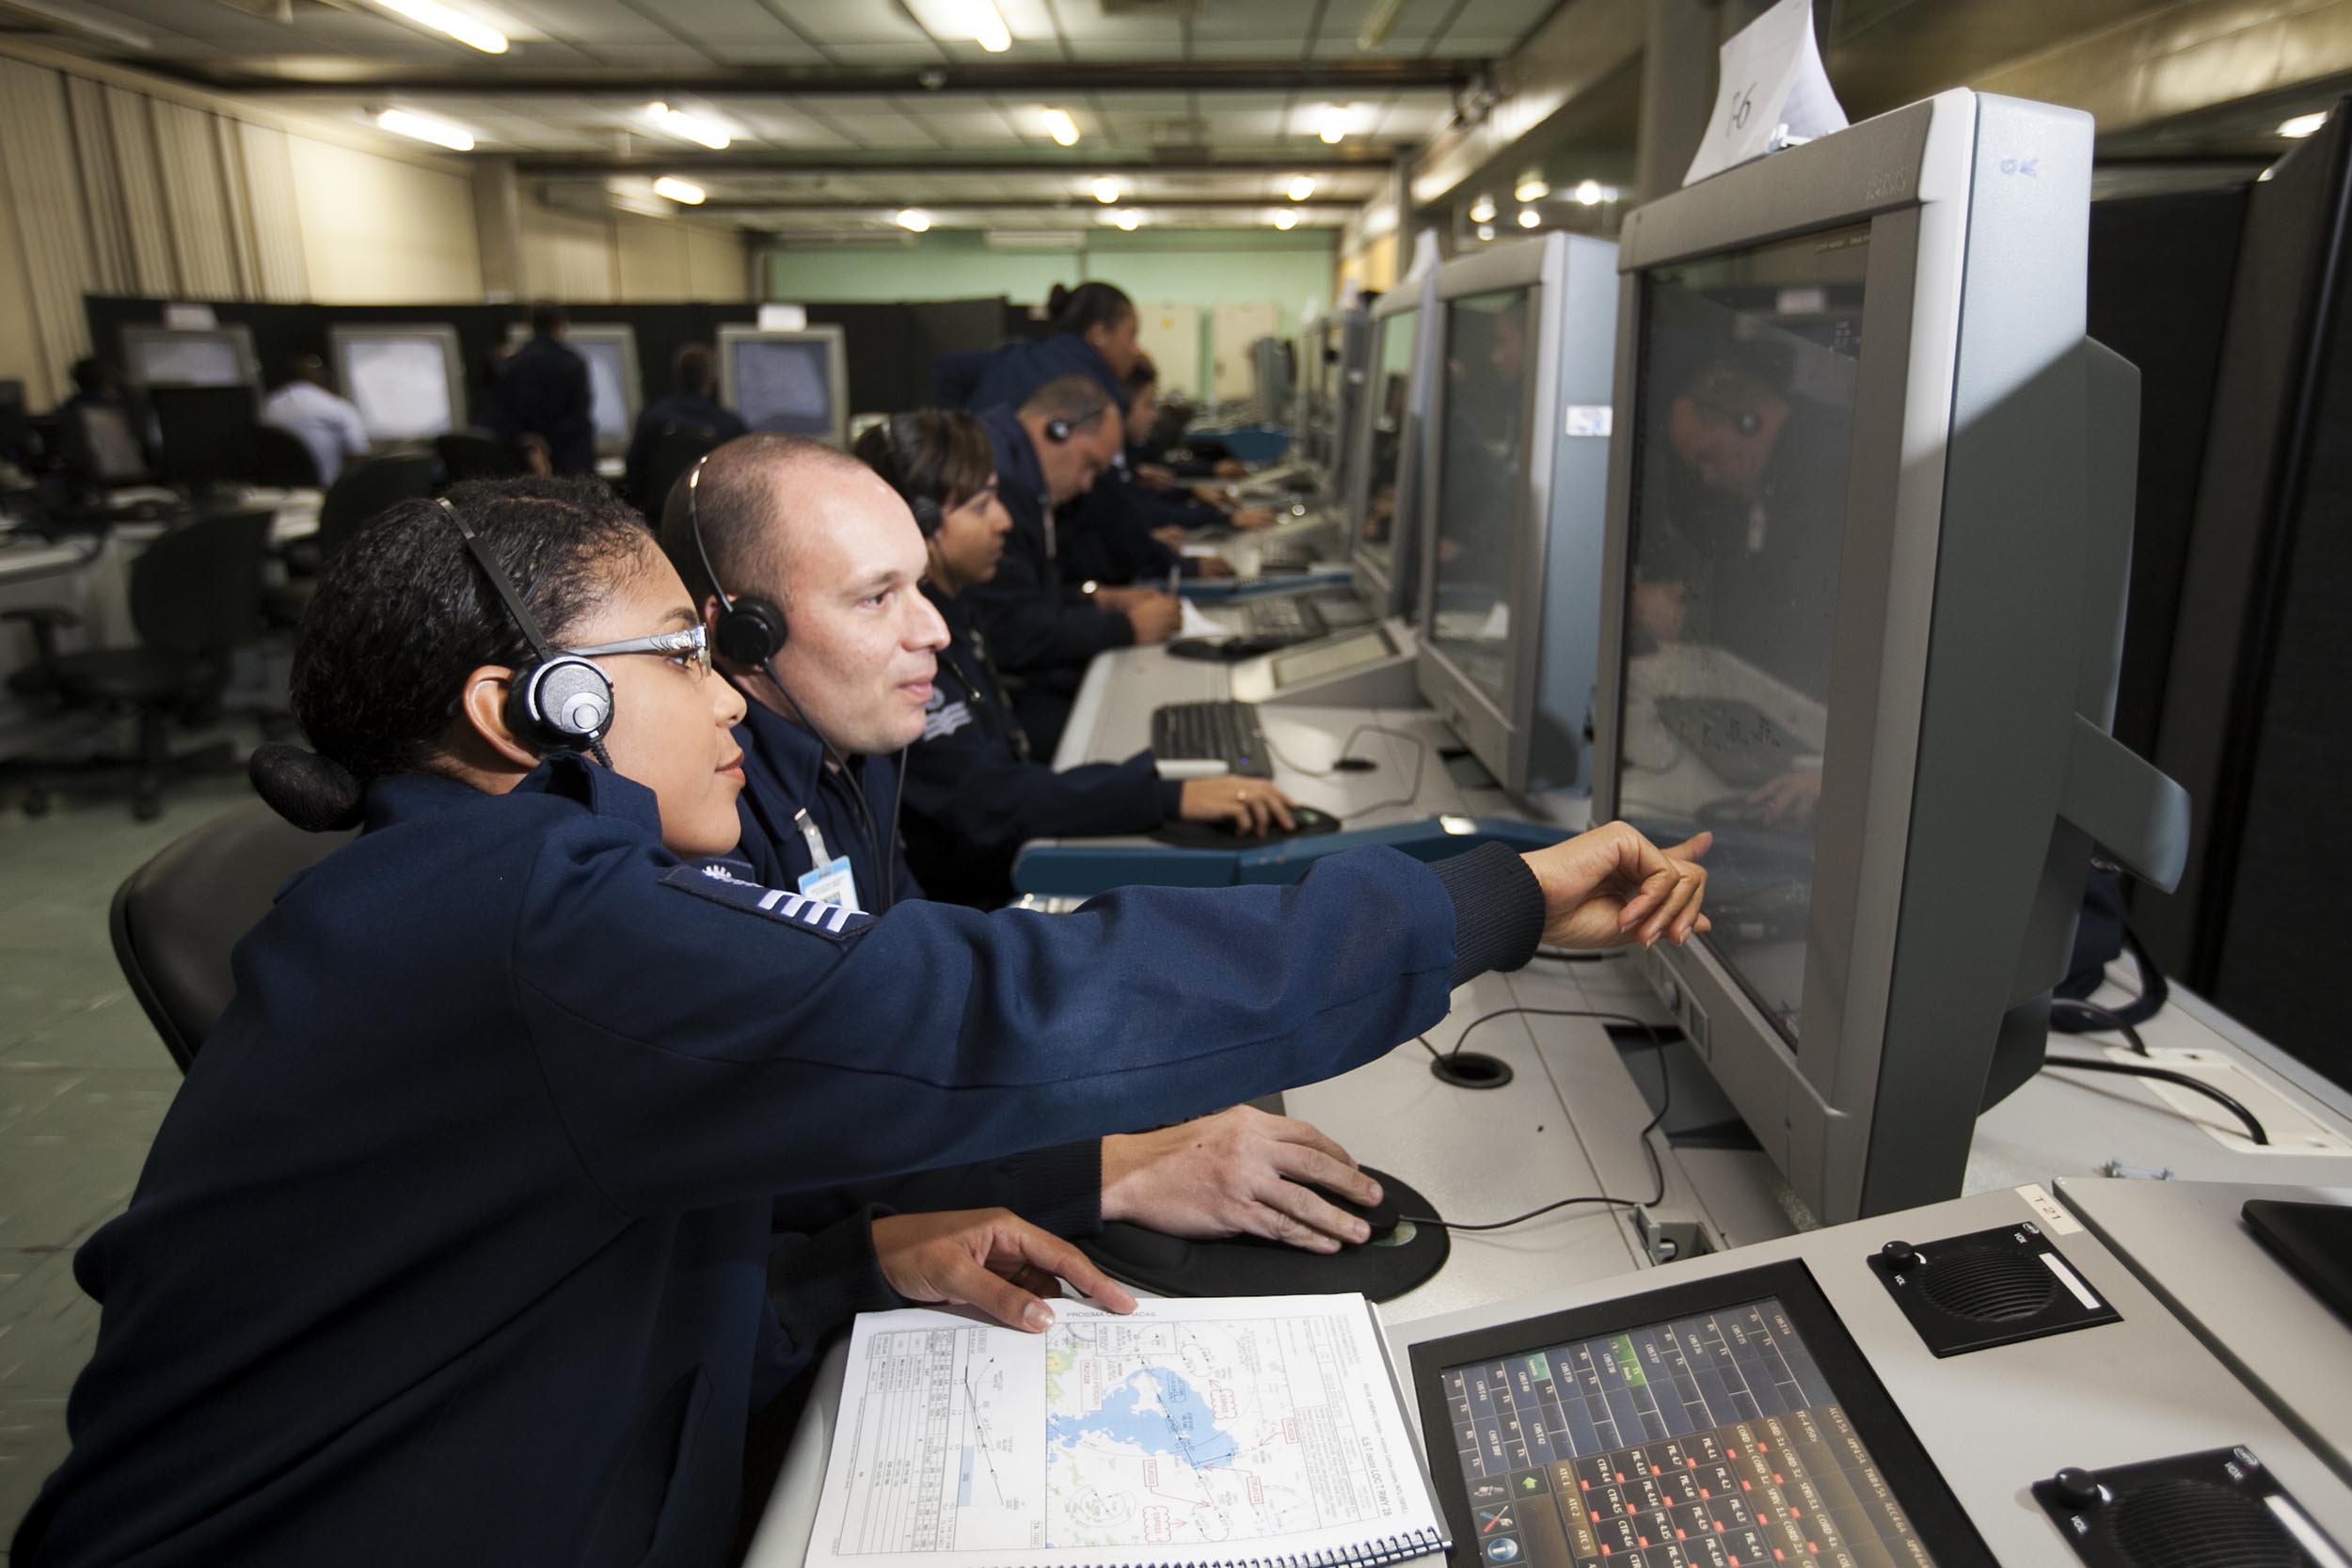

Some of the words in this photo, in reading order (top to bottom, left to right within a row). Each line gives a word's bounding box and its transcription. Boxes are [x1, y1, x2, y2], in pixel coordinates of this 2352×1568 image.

[2042, 1207, 2062, 1220] 21
[2014, 1232, 2027, 1243] VOX
[1895, 1275, 1906, 1286] VOL
[1596, 1458, 1608, 1471] CTR
[2224, 1462, 2244, 1480] VOX
[1557, 1466, 1569, 1481] ATC
[1606, 1488, 1618, 1502] CTR
[1566, 1497, 1579, 1512] ATC
[1617, 1519, 1630, 1534] CTR
[2071, 1515, 2087, 1533] VOL
[1576, 1528, 1589, 1544] ATC
